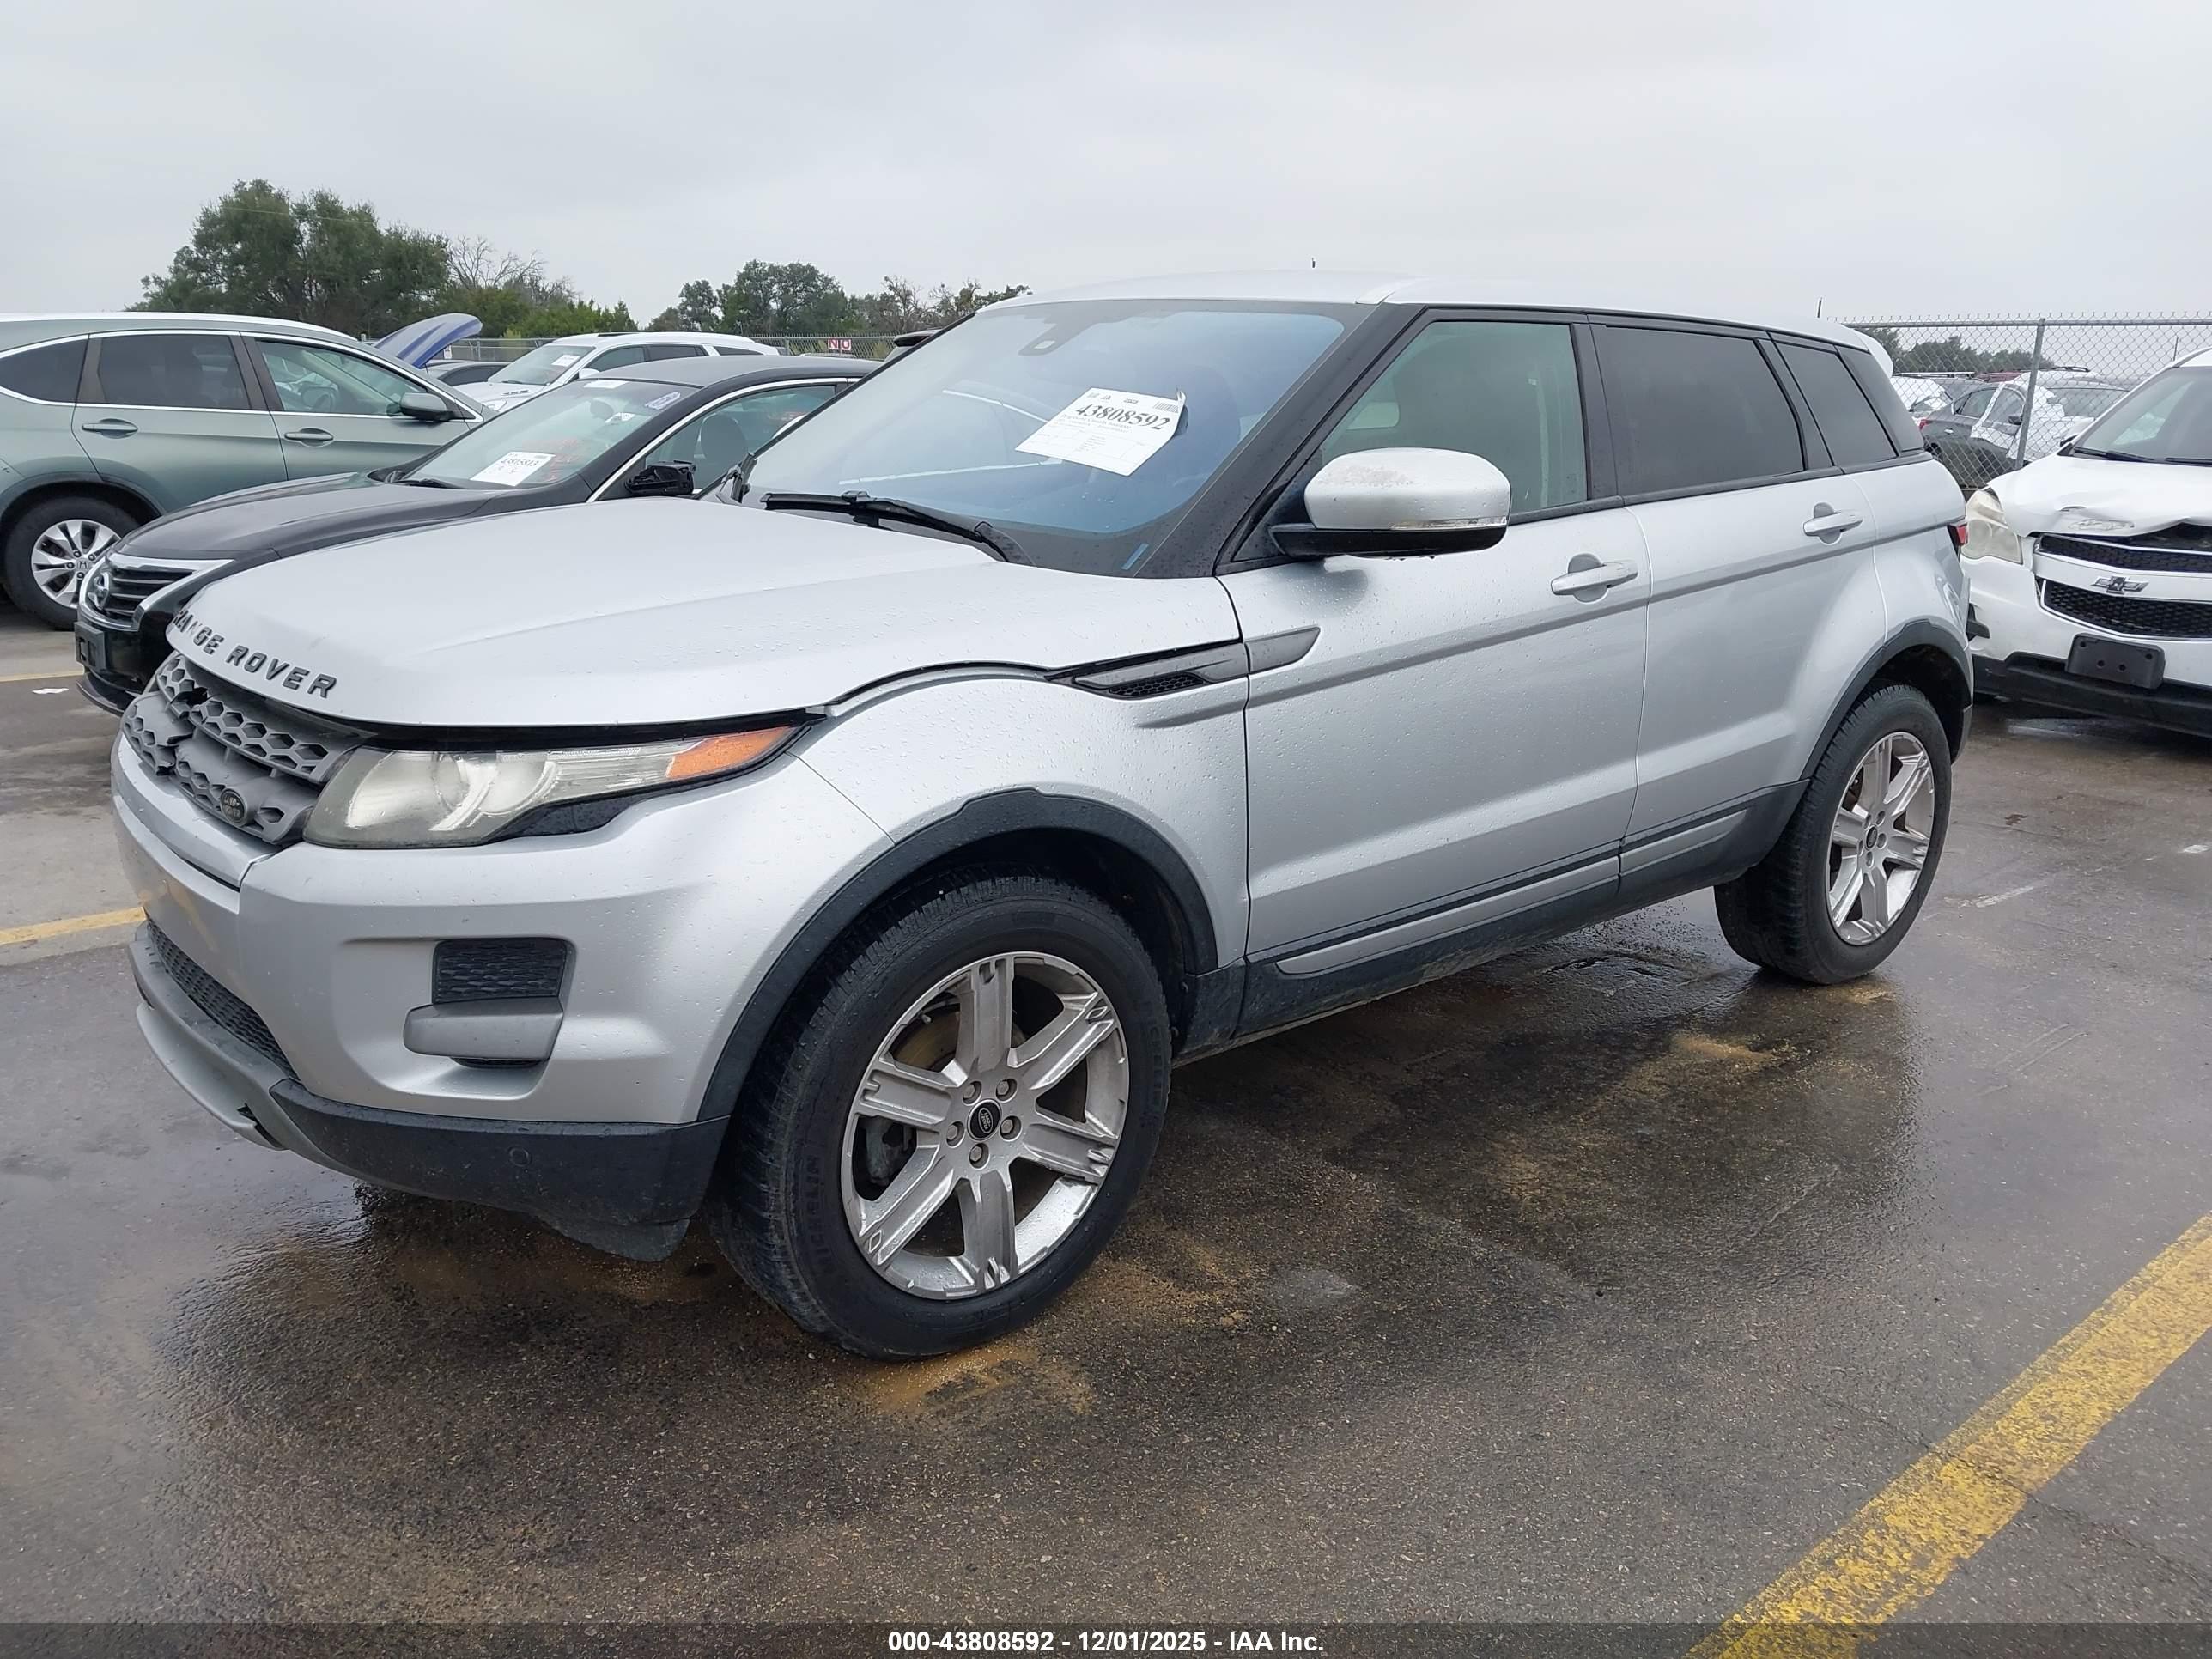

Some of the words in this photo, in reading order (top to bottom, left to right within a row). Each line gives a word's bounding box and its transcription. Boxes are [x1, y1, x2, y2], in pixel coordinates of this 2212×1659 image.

[829, 338, 850, 349] NO
[1075, 403, 1170, 430] 43808592
[225, 645, 337, 699] ROVER
